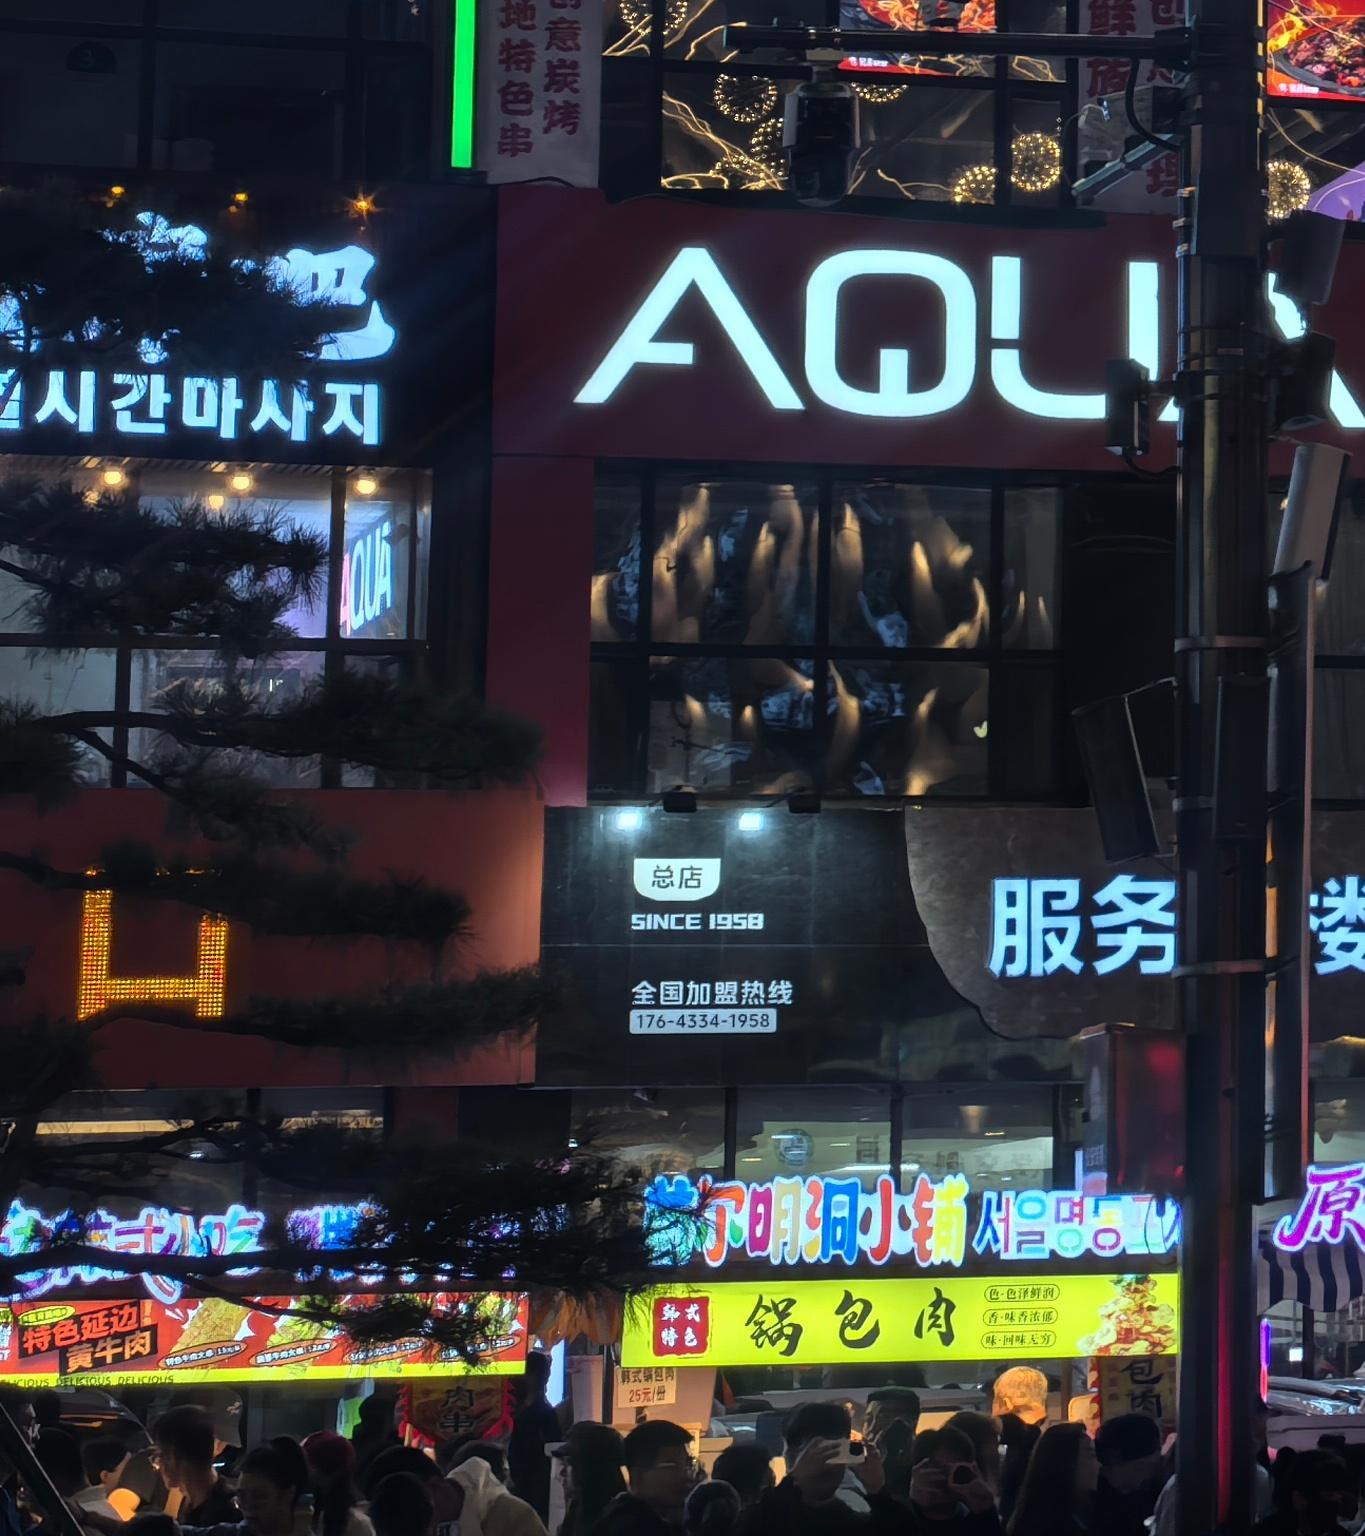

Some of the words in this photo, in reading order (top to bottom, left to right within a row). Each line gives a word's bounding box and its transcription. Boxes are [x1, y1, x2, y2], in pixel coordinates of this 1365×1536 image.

[651, 865, 704, 889] 总店
[631, 912, 702, 931] SINCE
[709, 912, 765, 931] 1958
[631, 979, 794, 1007] 全国加盟热线
[636, 1014, 770, 1030] 176-4334-1958
[745, 1286, 957, 1358] 锅包肉
[66, 1331, 151, 1373] 黄牛肉
